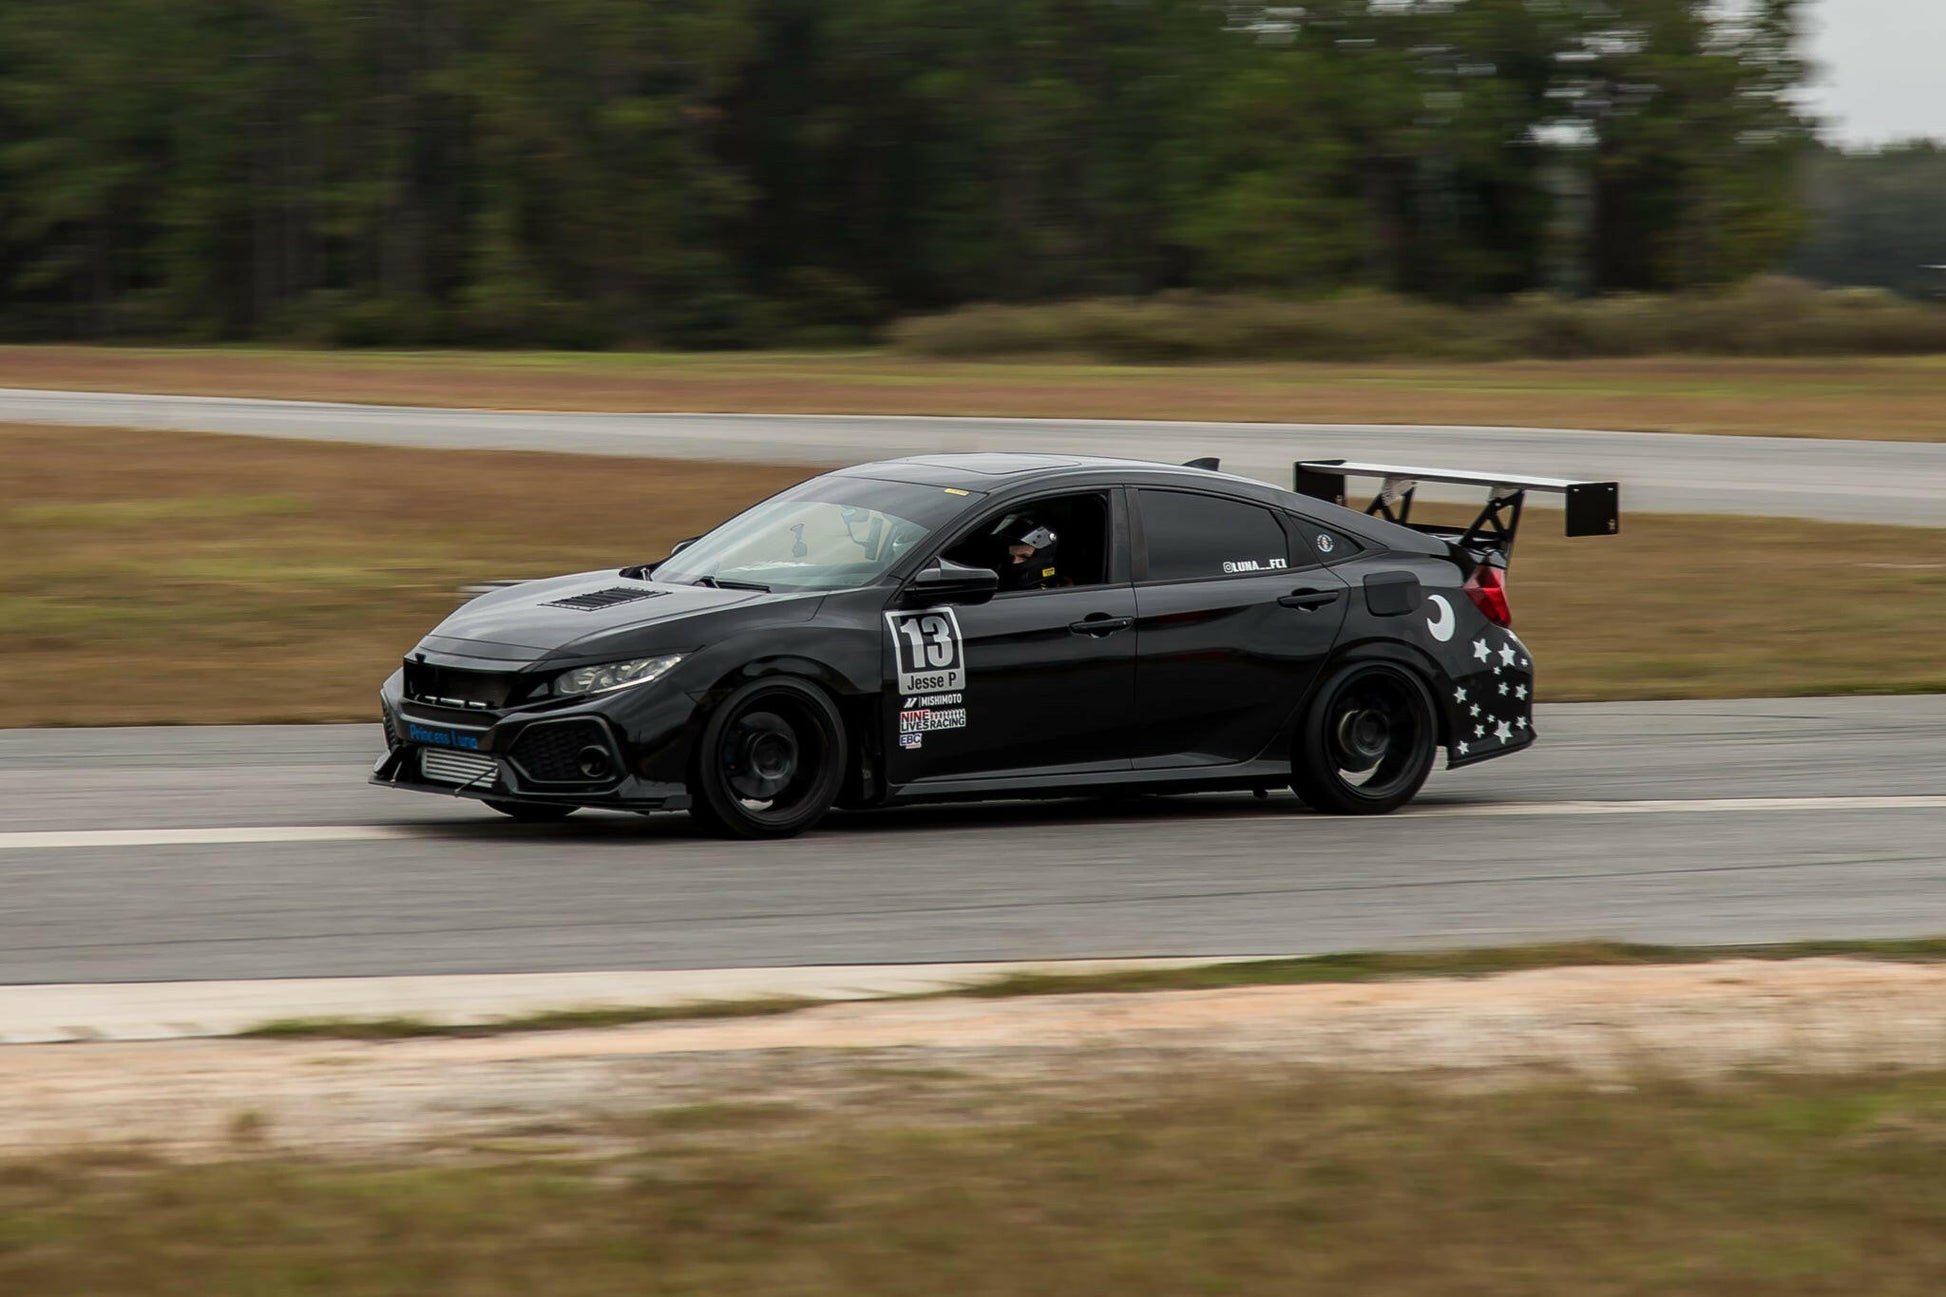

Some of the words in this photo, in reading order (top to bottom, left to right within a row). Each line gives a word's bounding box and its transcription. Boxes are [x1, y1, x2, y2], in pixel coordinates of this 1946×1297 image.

[900, 615, 954, 669] 13
[907, 675, 945, 691] Jesse
[948, 671, 957, 687] P
[921, 693, 963, 707] MISHIMOTO
[901, 709, 930, 722] NINE
[900, 734, 921, 745] EBC
